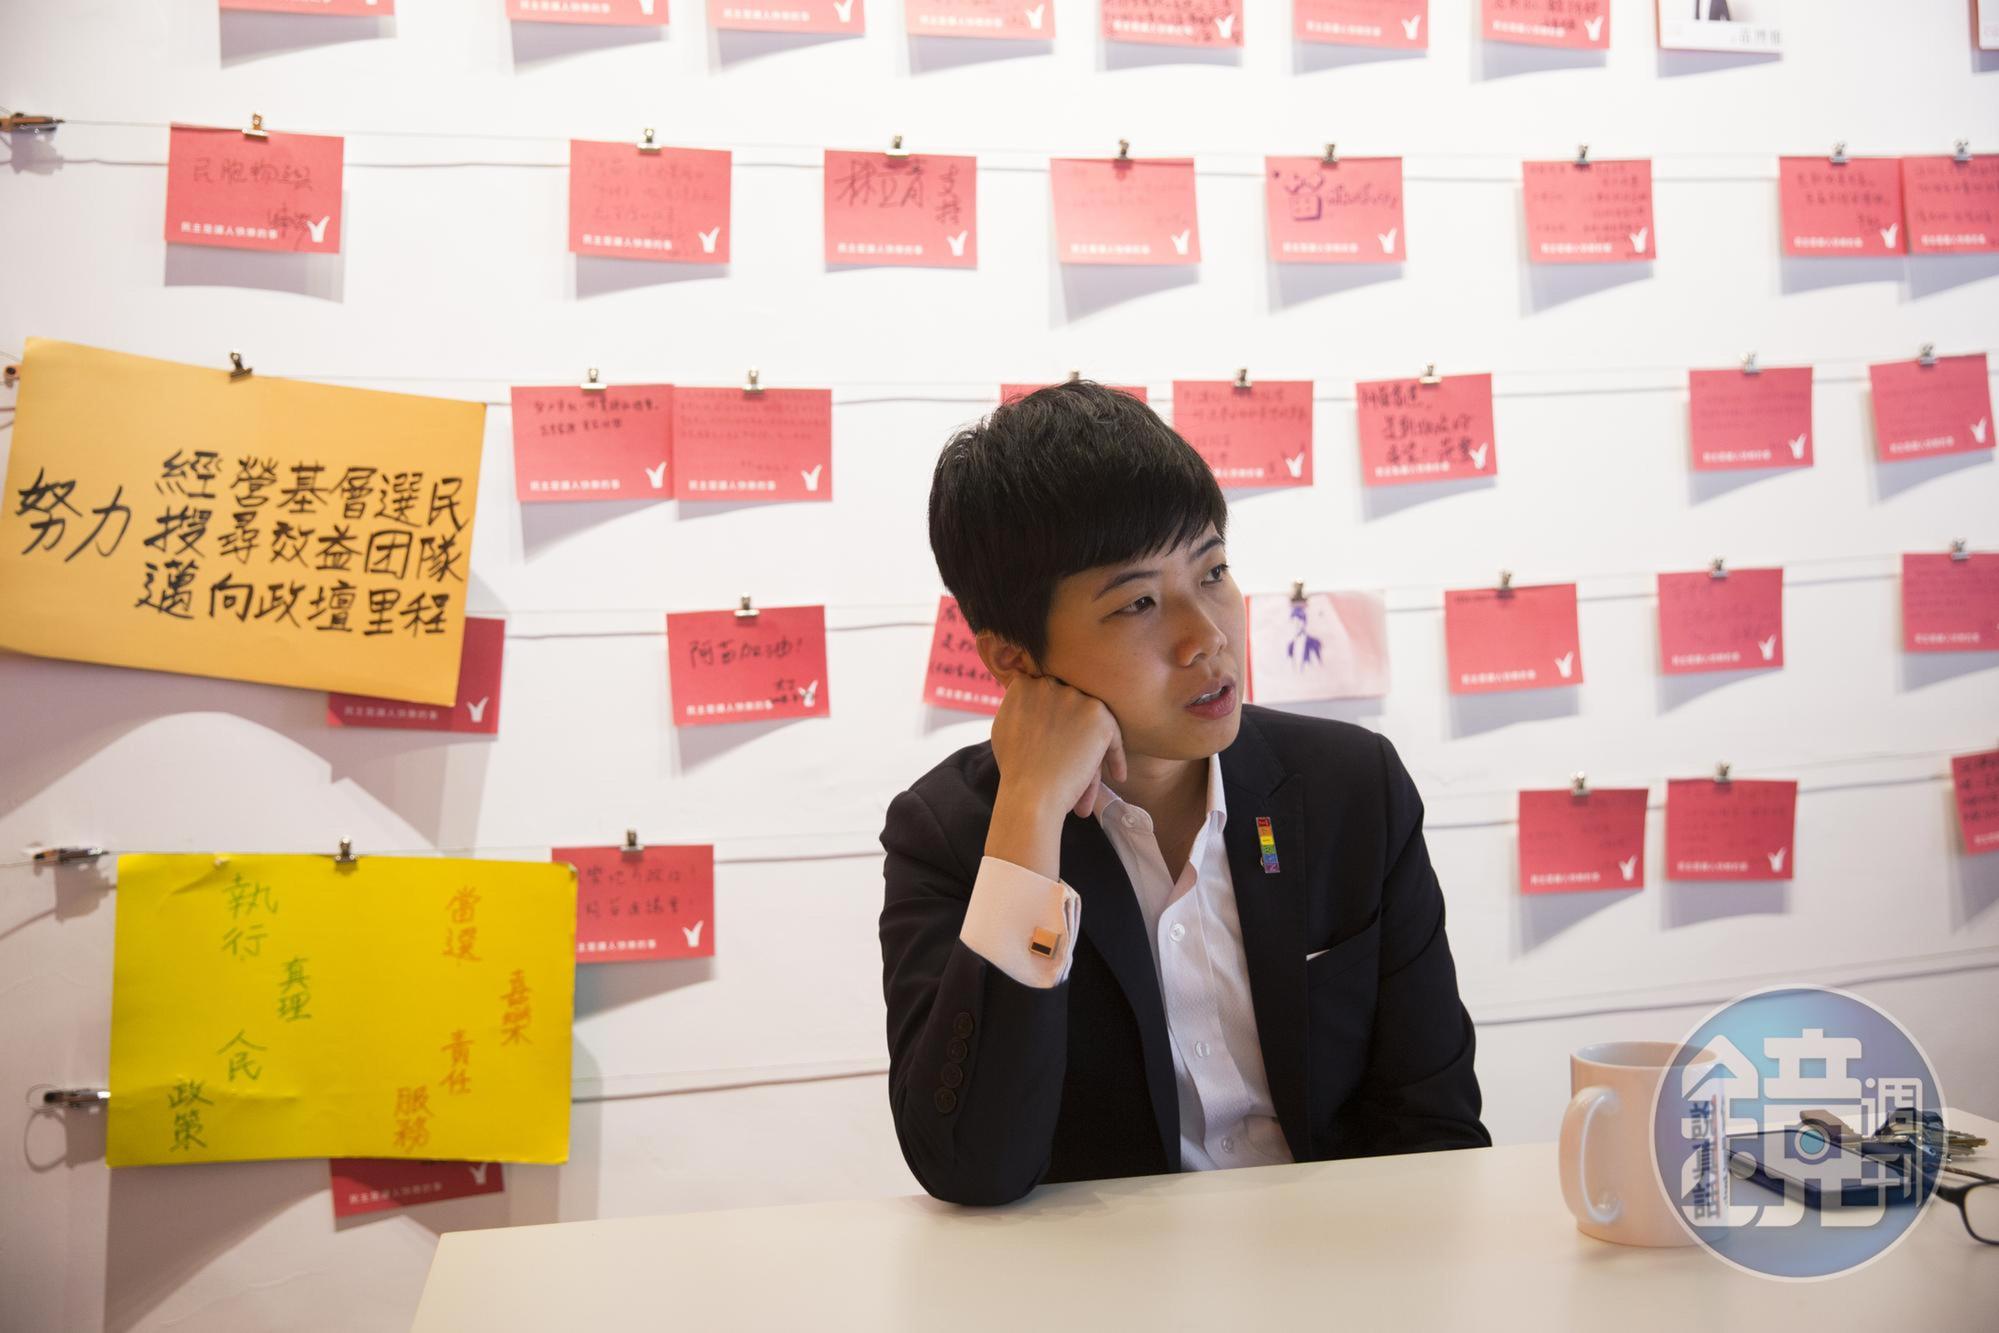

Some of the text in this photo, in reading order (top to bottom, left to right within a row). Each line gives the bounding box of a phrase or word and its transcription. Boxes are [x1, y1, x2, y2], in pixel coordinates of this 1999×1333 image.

[14, 467, 131, 563] 努力
[155, 448, 469, 532] 經營基層選民
[135, 560, 452, 639] 邁向政壇里程
[221, 872, 279, 960] 執行
[442, 884, 482, 966] 當選
[276, 955, 313, 1023] 真理
[216, 1028, 268, 1083] 人民
[439, 1028, 475, 1097] 責任
[166, 1077, 215, 1153] 政策
[392, 1085, 434, 1155] 服務
